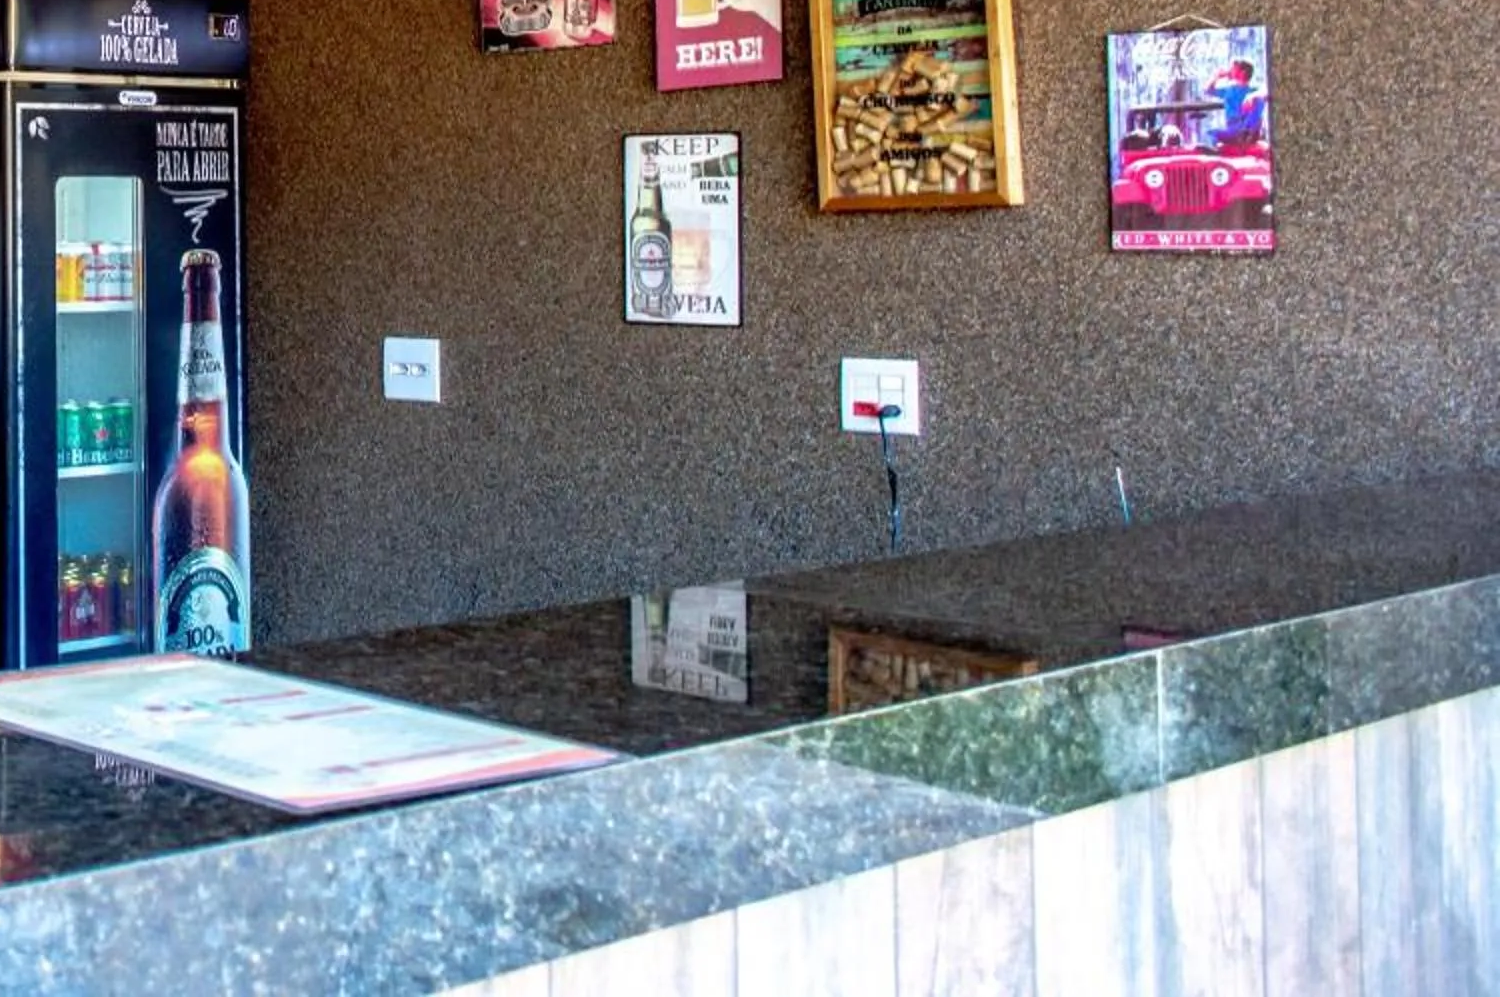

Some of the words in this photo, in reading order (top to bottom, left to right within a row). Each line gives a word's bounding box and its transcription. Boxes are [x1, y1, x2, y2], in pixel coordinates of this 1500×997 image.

[121, 15, 161, 36] CERVEJA
[100, 35, 132, 62] 100%
[133, 37, 178, 64] GELADA
[675, 36, 763, 71] HERE!
[654, 137, 718, 155] KEEP
[156, 150, 190, 182] PARA
[193, 150, 230, 182] ABRIR
[185, 624, 224, 649] 100%
